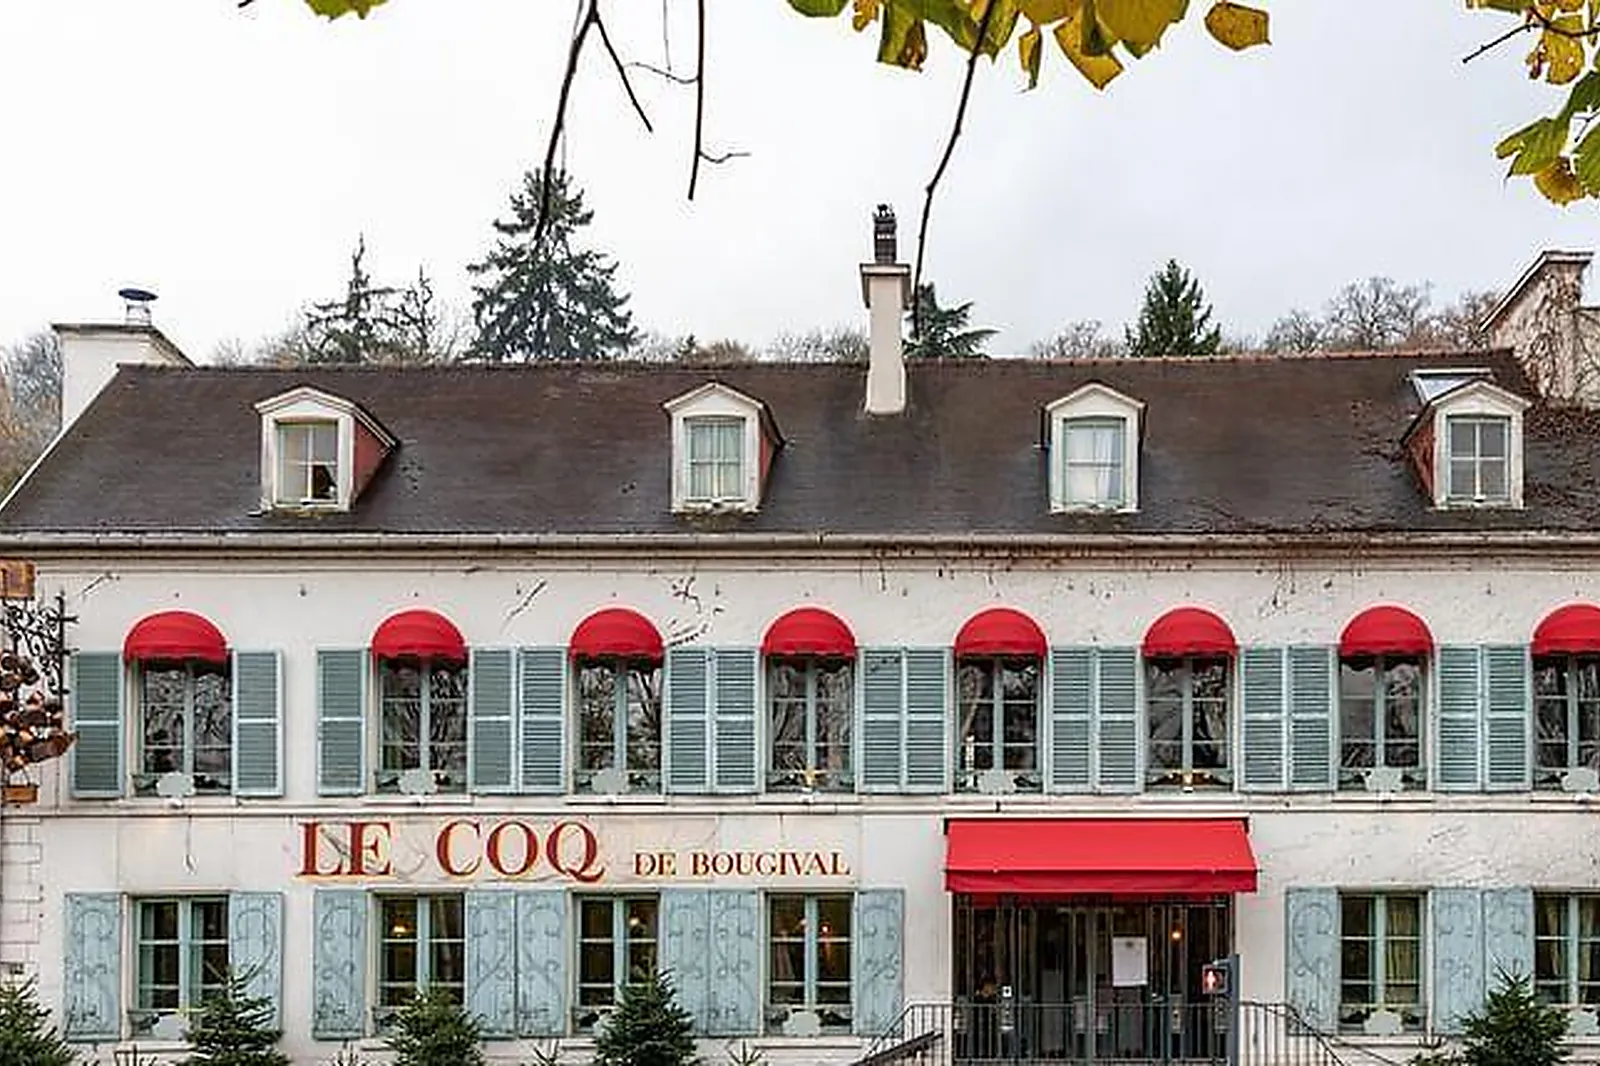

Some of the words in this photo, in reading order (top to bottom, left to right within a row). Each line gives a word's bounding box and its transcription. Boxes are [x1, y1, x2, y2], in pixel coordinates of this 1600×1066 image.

[297, 820, 393, 877] LE
[435, 820, 605, 883] COQ
[633, 852, 677, 876] DE
[691, 851, 851, 876] BOUGIVAL
